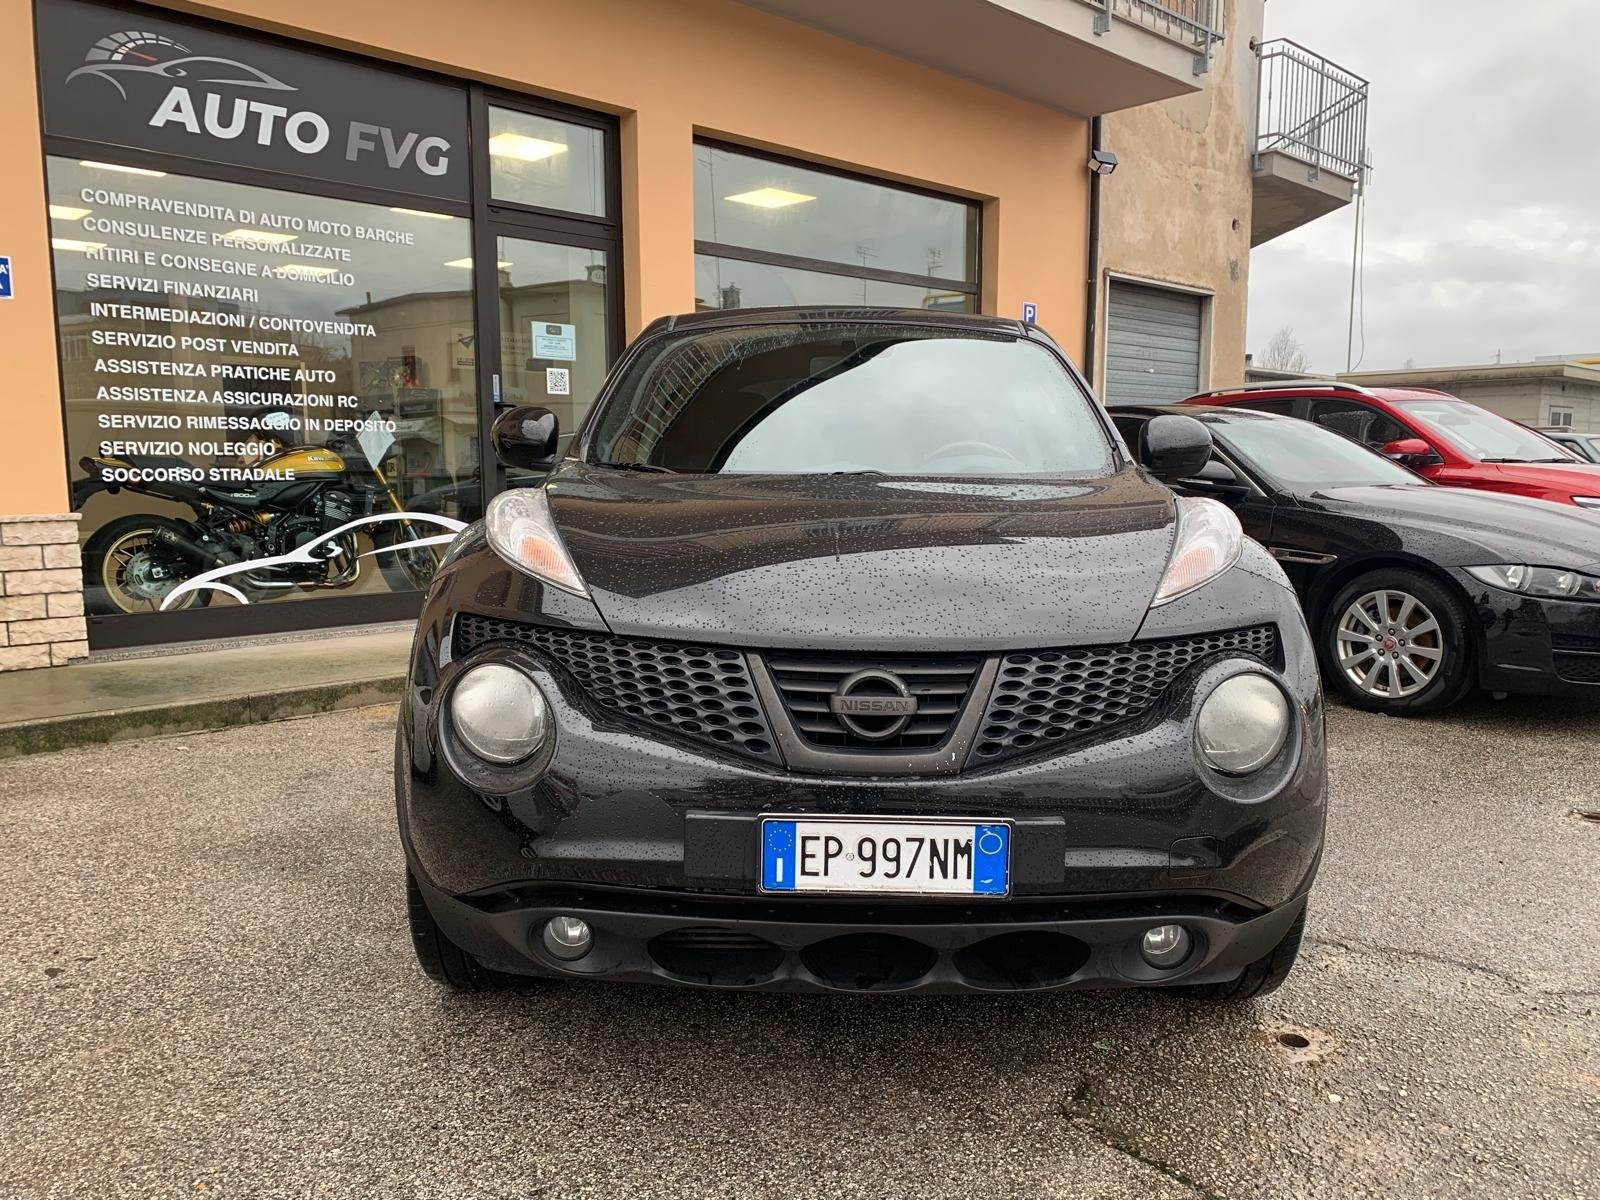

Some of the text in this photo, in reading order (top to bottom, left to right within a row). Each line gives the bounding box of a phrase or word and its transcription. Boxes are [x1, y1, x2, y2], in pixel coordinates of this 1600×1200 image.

[148, 86, 452, 176] AUTO FVG
[81, 188, 415, 246] COMPRAVENDITA DI AUTO MOTO BARCHE
[83, 217, 352, 262] CONSULENZE PERSONALIZZATE
[86, 246, 355, 287] RITIRI E CONSEGNE A DOMICILIO
[86, 273, 259, 302] SERVIZI FINANZIARI
[90, 302, 245, 328] INTERMEDIAZIONI
[259, 316, 376, 337] CONTOVENDITA
[1026, 306, 1034, 322] P
[91, 331, 299, 357] SERVIZIO POST VENDITA
[94, 358, 336, 383] ASSISTENZA PRATICHE AUTO
[96, 386, 358, 408] ASSISTENZA ASSICURAZIONI RC
[98, 414, 397, 432] SERVIZIO RIMESSAGGIO IN DEPOSITO
[100, 441, 276, 456] SERVIZIO NOLEGGIO
[102, 467, 296, 482] SOCCORSO STRADALE
[840, 699, 909, 712] NISSAN
[800, 835, 843, 877] EP
[857, 838, 973, 880] 997NM
